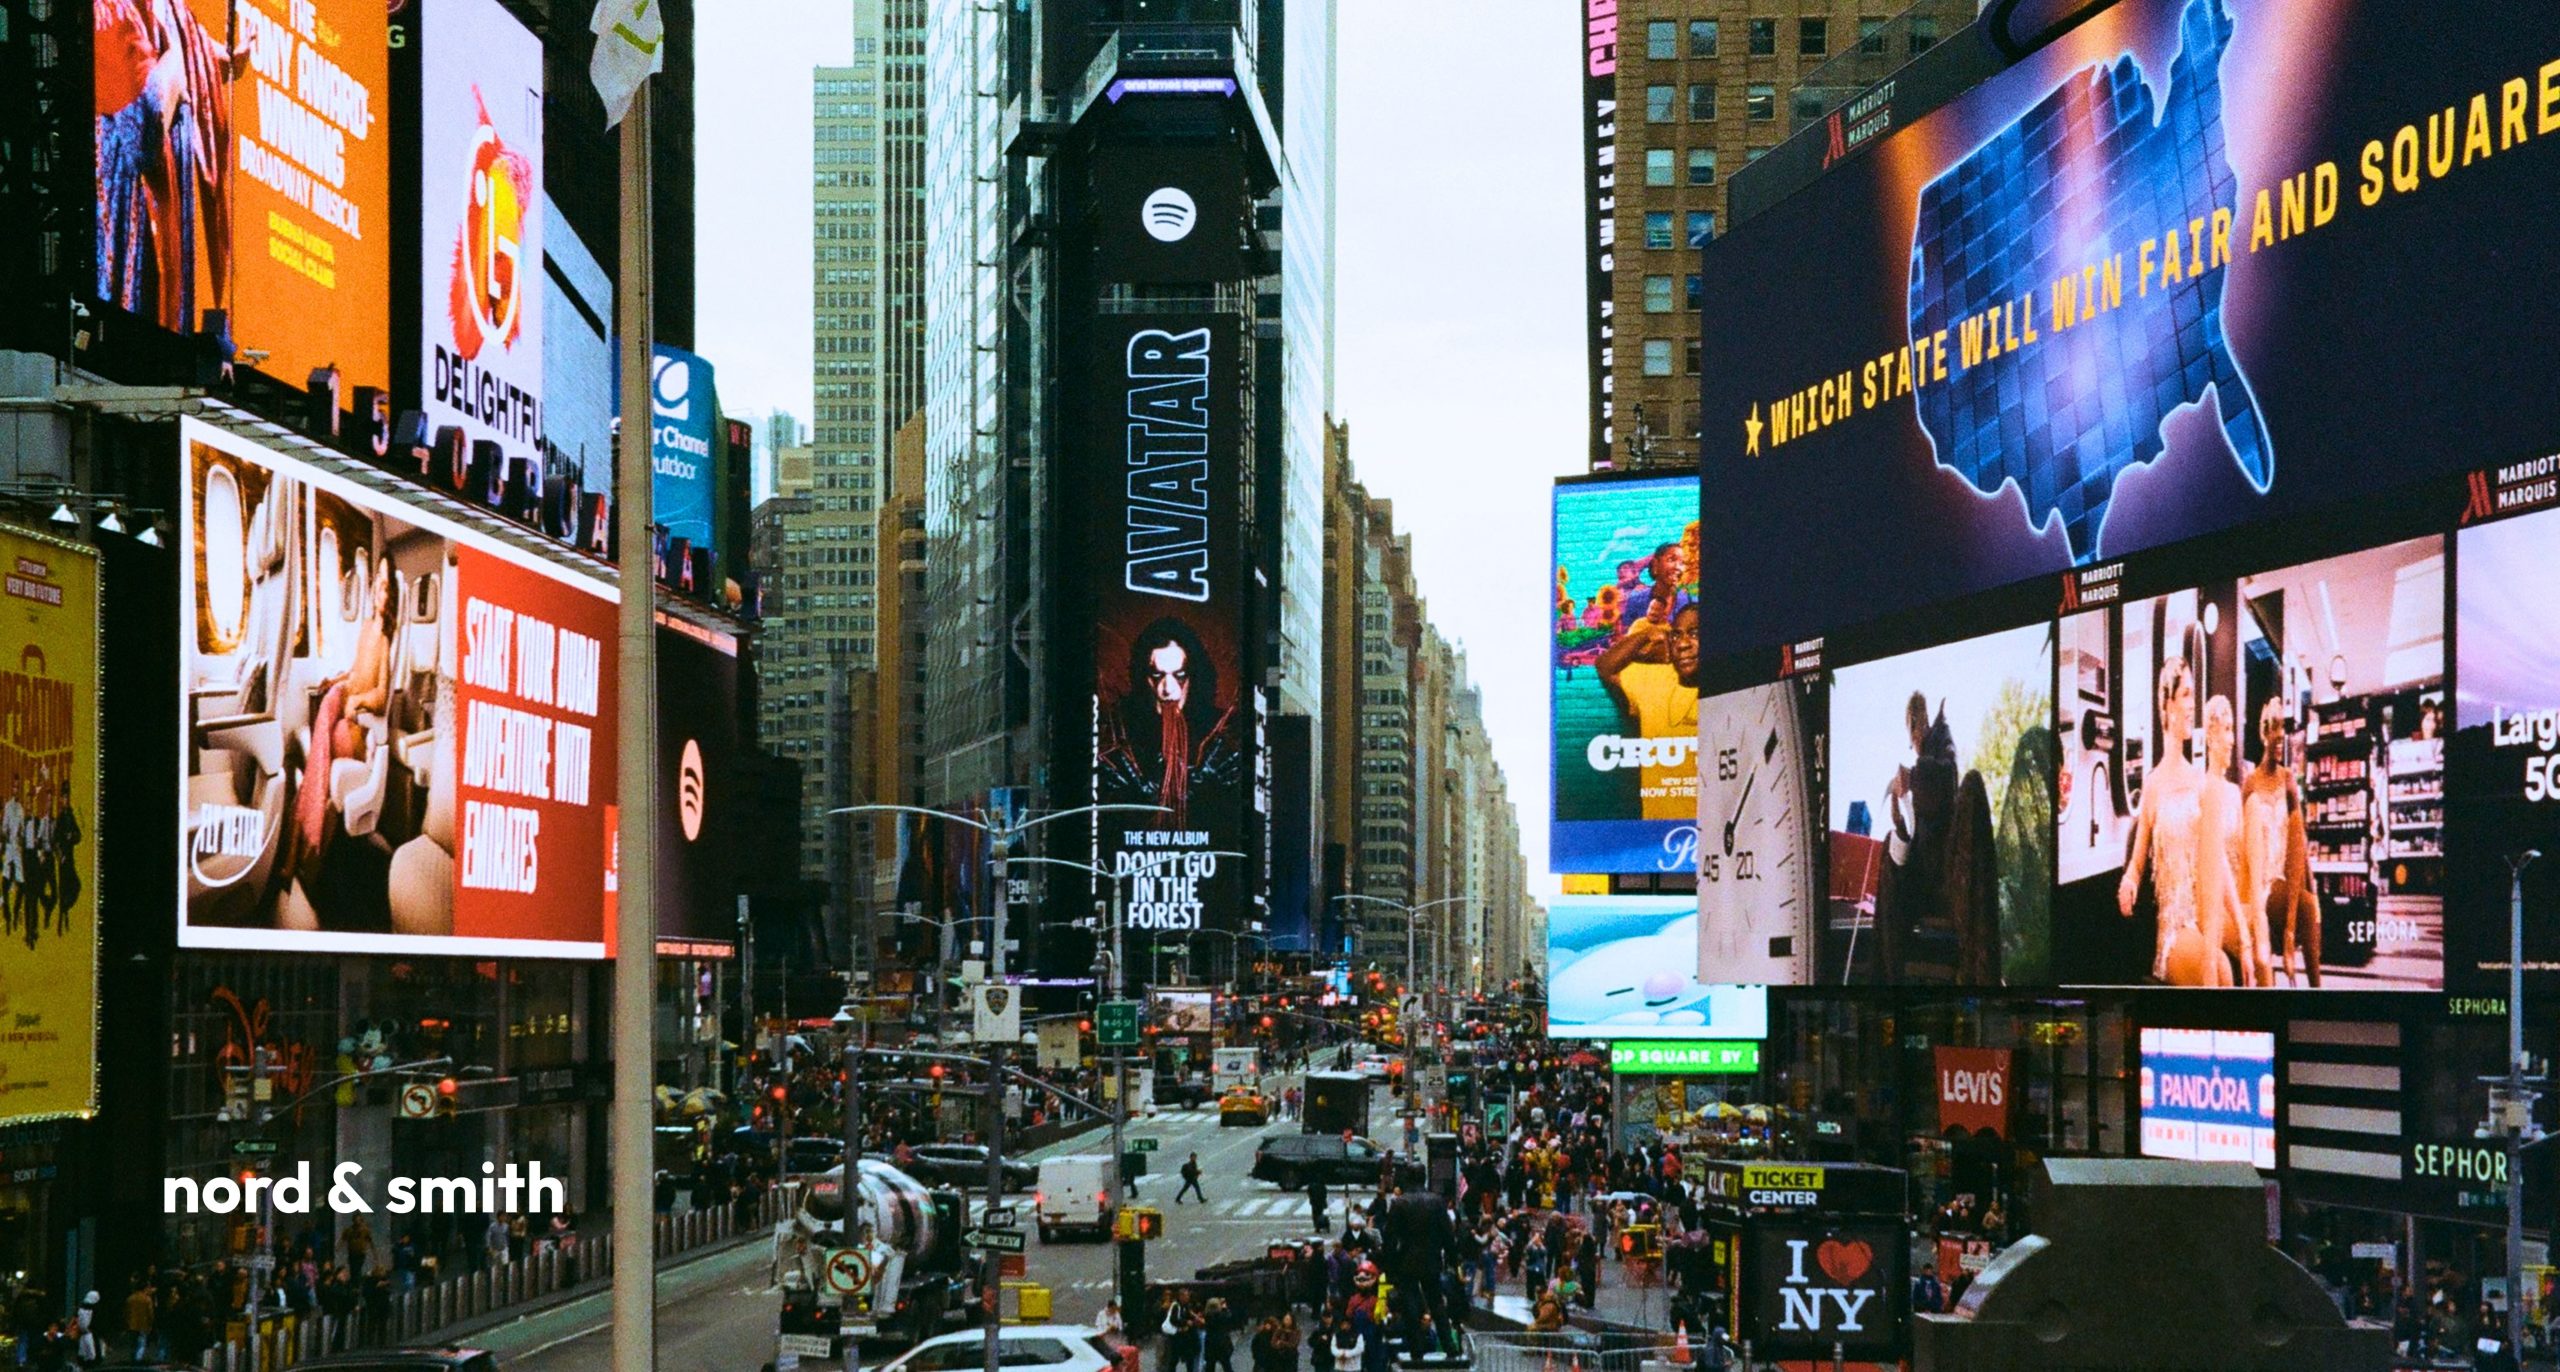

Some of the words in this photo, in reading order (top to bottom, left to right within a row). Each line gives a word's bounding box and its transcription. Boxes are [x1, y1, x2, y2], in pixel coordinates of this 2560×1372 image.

[1124, 80, 1147, 91] one
[1148, 79, 1181, 91] times
[1183, 80, 1223, 92] square
[1849, 80, 1895, 123] MARRIOTT
[257, 78, 345, 189] WINNING
[1848, 108, 1890, 148] MARQUIS
[240, 133, 311, 210] BROADWAY
[312, 179, 362, 240] MUSICAL
[268, 235, 305, 275] SOCIAL
[306, 257, 335, 289] CLUB
[1771, 371, 1851, 447] WHICH
[1863, 329, 1948, 410] STATE
[1959, 294, 2038, 370] WILL
[2051, 253, 2122, 333] WIN
[2139, 206, 2232, 297] FAIR
[2250, 161, 2338, 253] AND
[2359, 58, 2560, 207] SQUARE
[662, 425, 710, 458] Channel
[653, 454, 696, 480] utdoor
[1126, 327, 1210, 602] AVATAR
[2498, 479, 2556, 508] MARQUIS
[2081, 562, 2124, 585] MARRIOTT
[2081, 583, 2119, 604] MARQUIS
[464, 596, 514, 693] START
[516, 612, 555, 706] YOUR
[556, 627, 600, 717] DUBAI
[1794, 637, 1824, 655] MARRIOTT
[1794, 654, 1821, 670] MARQUIS
[2493, 705, 2560, 751] Larg
[463, 698, 552, 800] ADVENTURE
[554, 719, 591, 806] WITH
[1718, 748, 1738, 781] 65
[1640, 787, 1667, 798] NOW
[462, 800, 539, 894] EMIRATES
[1124, 831, 1144, 845] THE
[1146, 831, 1171, 845] NEW
[1172, 831, 1209, 845] ALBUM
[1116, 851, 1180, 877] DON'T
[1184, 852, 1217, 878] GO
[1703, 854, 1720, 883] 45
[1133, 877, 1155, 902] IN
[1160, 877, 1198, 902] THE
[1128, 902, 1204, 929] FOREST
[2348, 920, 2418, 943] SEPHORA
[2449, 998, 2507, 1016] SEPHORA
[1640, 1050, 1711, 1064] SQUARE
[1722, 1050, 1742, 1064] BY
[2161, 1069, 2251, 1113] PANDORA
[2415, 1143, 2523, 1184] SEPHOR
[1751, 1171, 1817, 1186] TICKET
[1750, 1190, 1817, 1205] CENTER
[1786, 1240, 1808, 1283] I
[1778, 1288, 1875, 1331] NY
